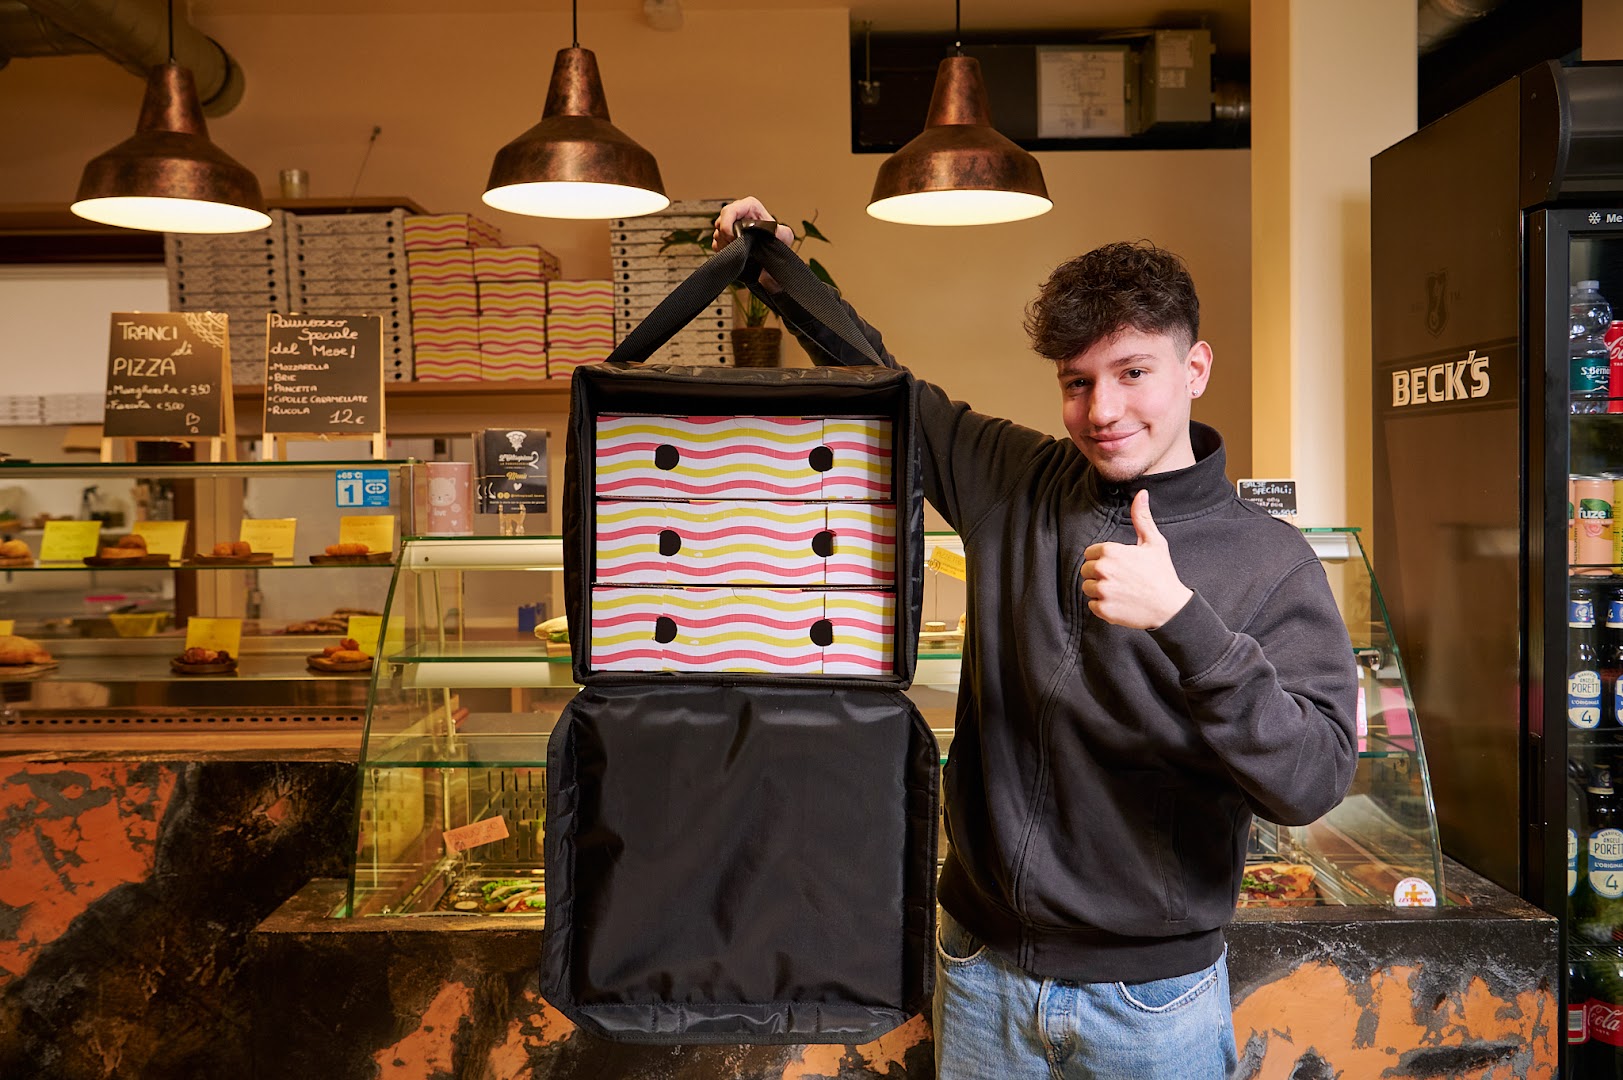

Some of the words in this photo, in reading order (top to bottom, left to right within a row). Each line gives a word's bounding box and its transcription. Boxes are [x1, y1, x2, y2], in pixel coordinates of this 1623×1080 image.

[117, 321, 178, 341] TRANCI
[297, 327, 359, 346] Speciale
[171, 340, 193, 357] di
[269, 342, 301, 355] del
[113, 357, 177, 377] PIZZA
[1392, 350, 1490, 407] BECK'S
[344, 484, 355, 504] 1
[1581, 709, 1593, 724] 4
[1605, 874, 1618, 890] 4
